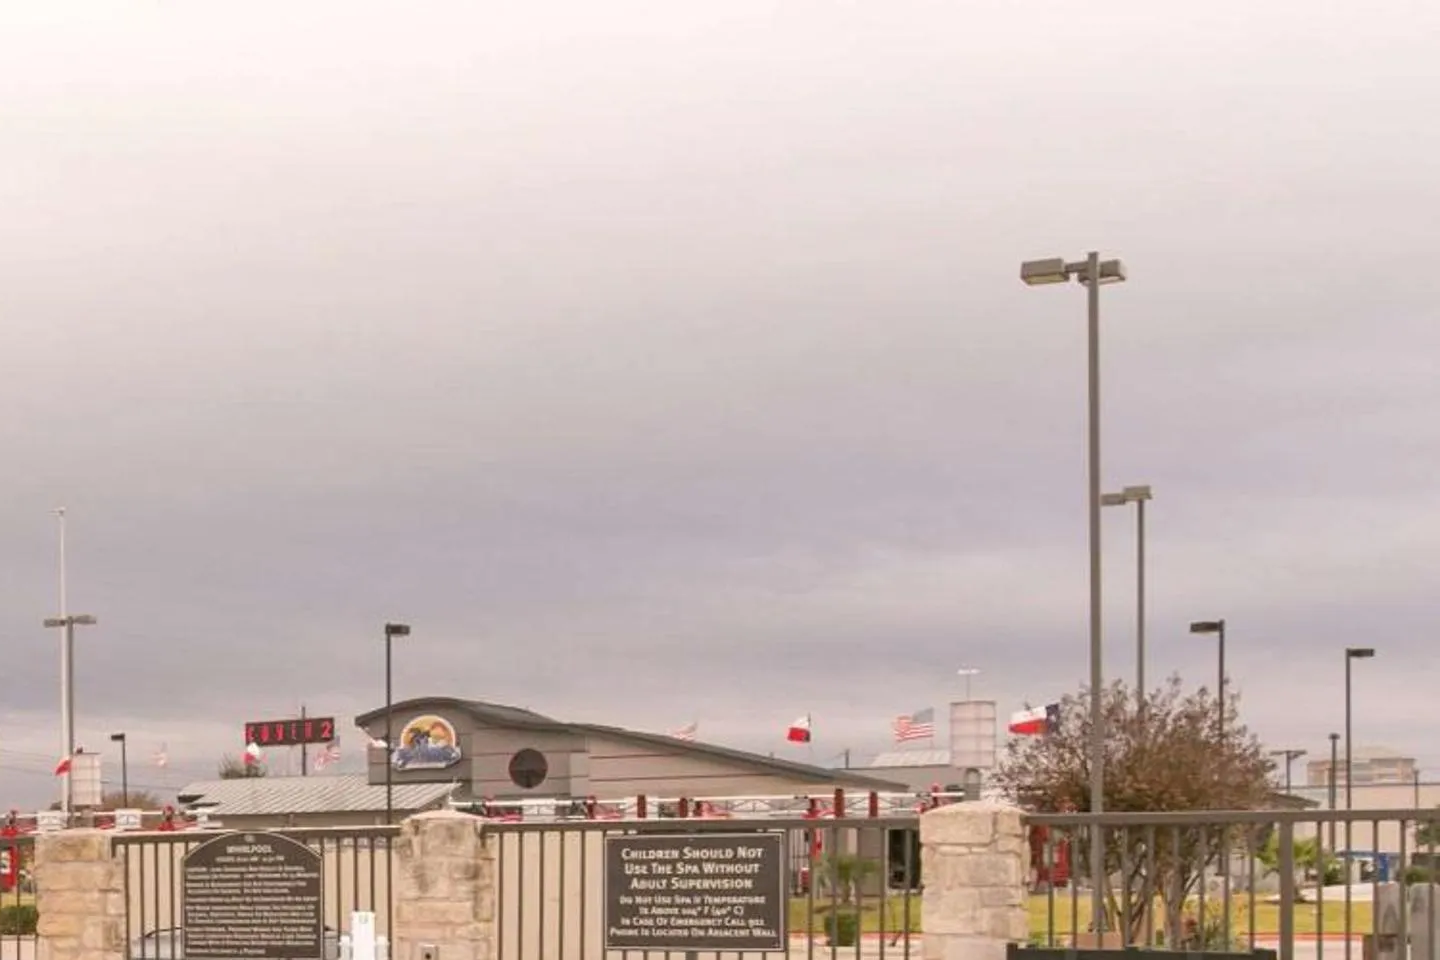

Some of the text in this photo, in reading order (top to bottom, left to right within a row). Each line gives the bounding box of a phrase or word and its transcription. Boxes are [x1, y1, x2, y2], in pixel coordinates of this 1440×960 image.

[621, 846, 764, 860] CHILDREN SHOULD NOT
[624, 862, 760, 874] USE THE SPA WITHOUT
[630, 877, 753, 889] ADULT SUPERVISION
